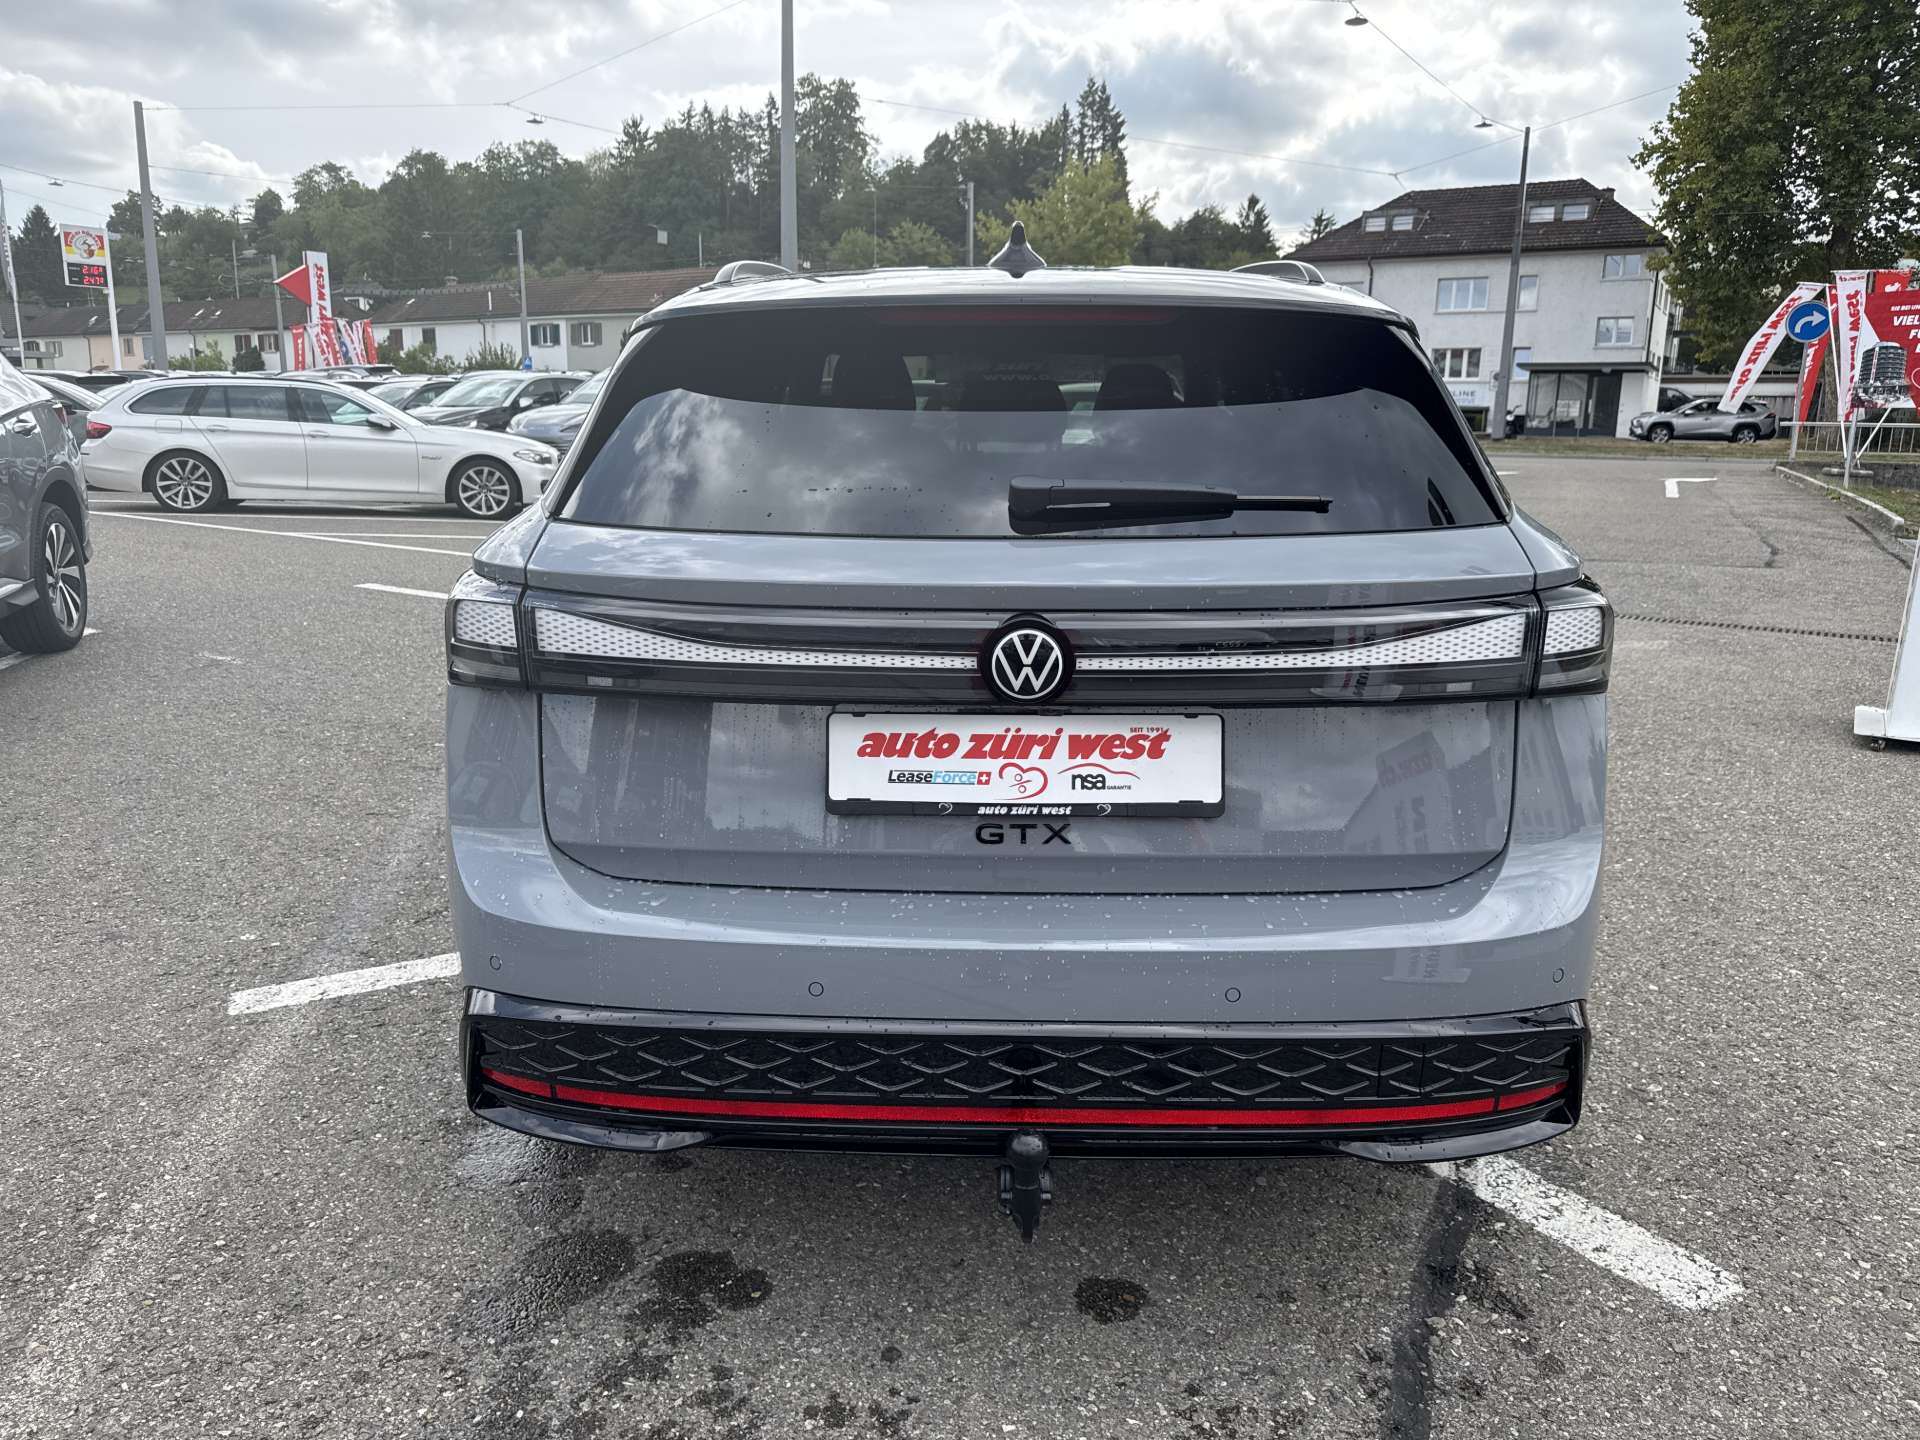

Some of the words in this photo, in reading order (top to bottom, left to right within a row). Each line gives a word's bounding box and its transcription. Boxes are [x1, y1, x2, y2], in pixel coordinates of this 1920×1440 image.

[856, 727, 961, 759] auto
[961, 727, 1064, 760] züri
[1068, 727, 1172, 760] west
[888, 770, 977, 784] LeaseForce
[1071, 773, 1106, 790] nsa
[977, 806, 1008, 815] auto
[1010, 805, 1040, 815] züri
[1041, 805, 1072, 815] west
[975, 823, 1072, 845] GTX
